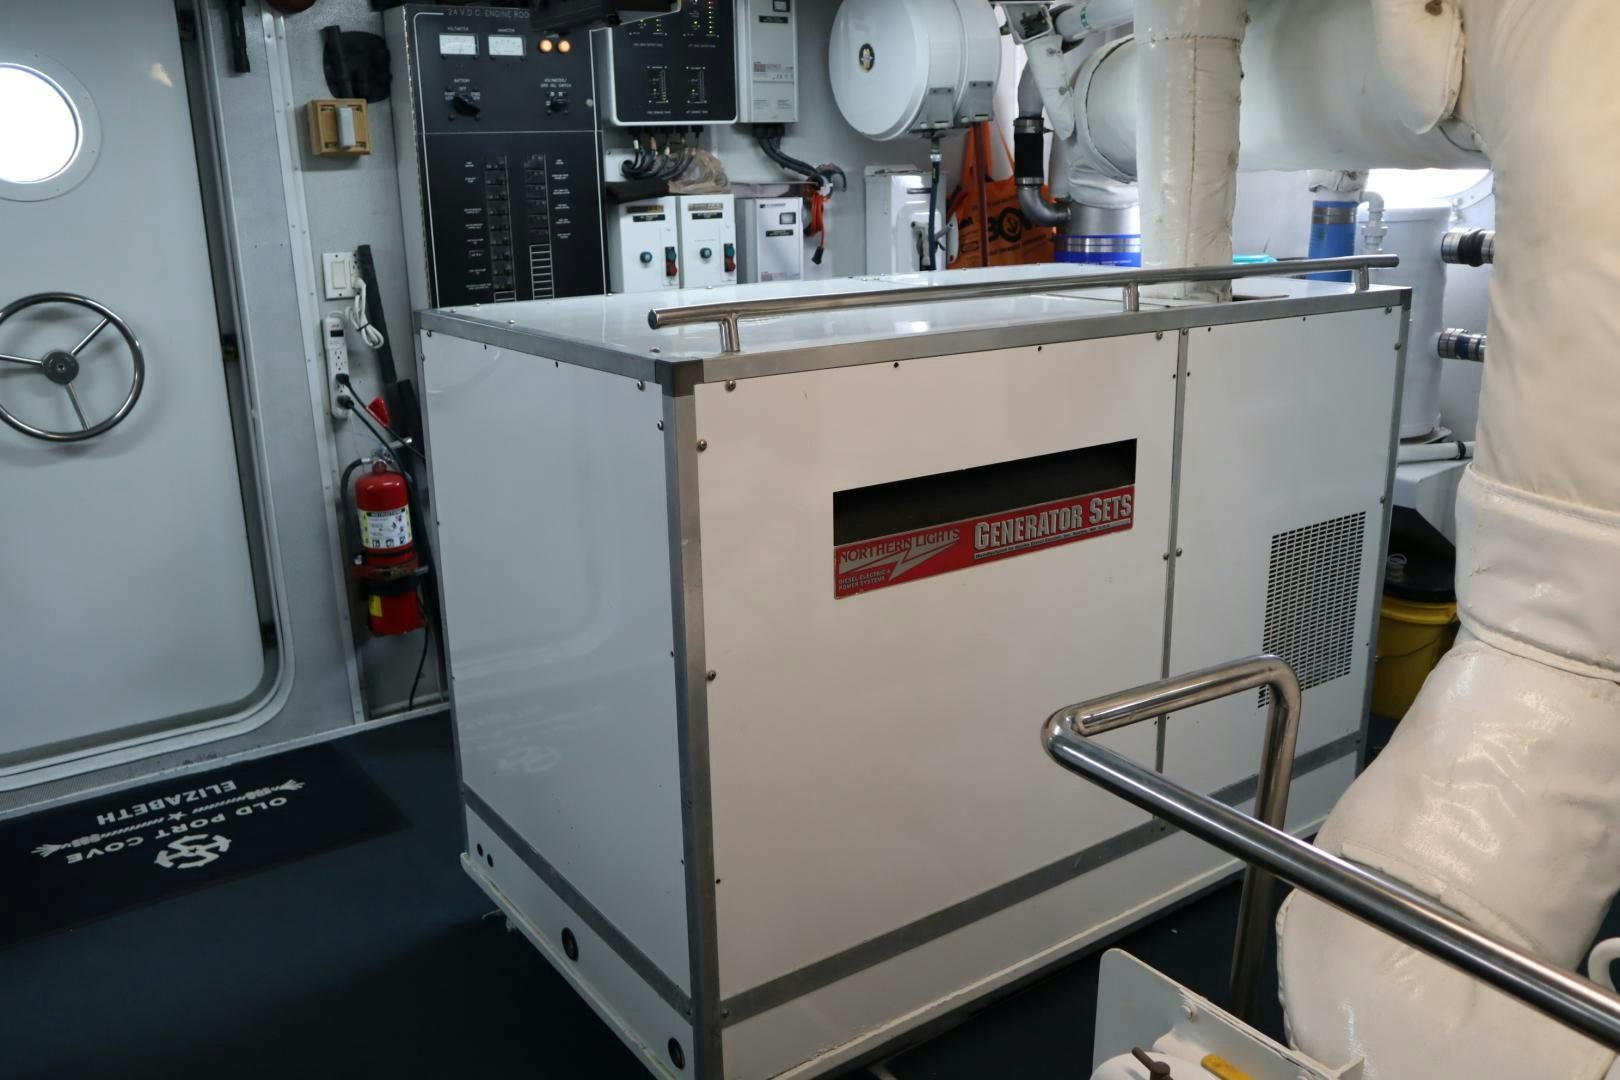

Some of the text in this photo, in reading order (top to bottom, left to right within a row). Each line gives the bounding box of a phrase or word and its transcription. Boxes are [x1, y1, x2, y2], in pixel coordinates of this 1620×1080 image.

[838, 528, 961, 564] NORTHERN LIGHTS
[974, 494, 1132, 551] GENERATOR SETS
[97, 780, 237, 826] ELIZABETH
[66, 797, 288, 864] OLD PORT COVE
